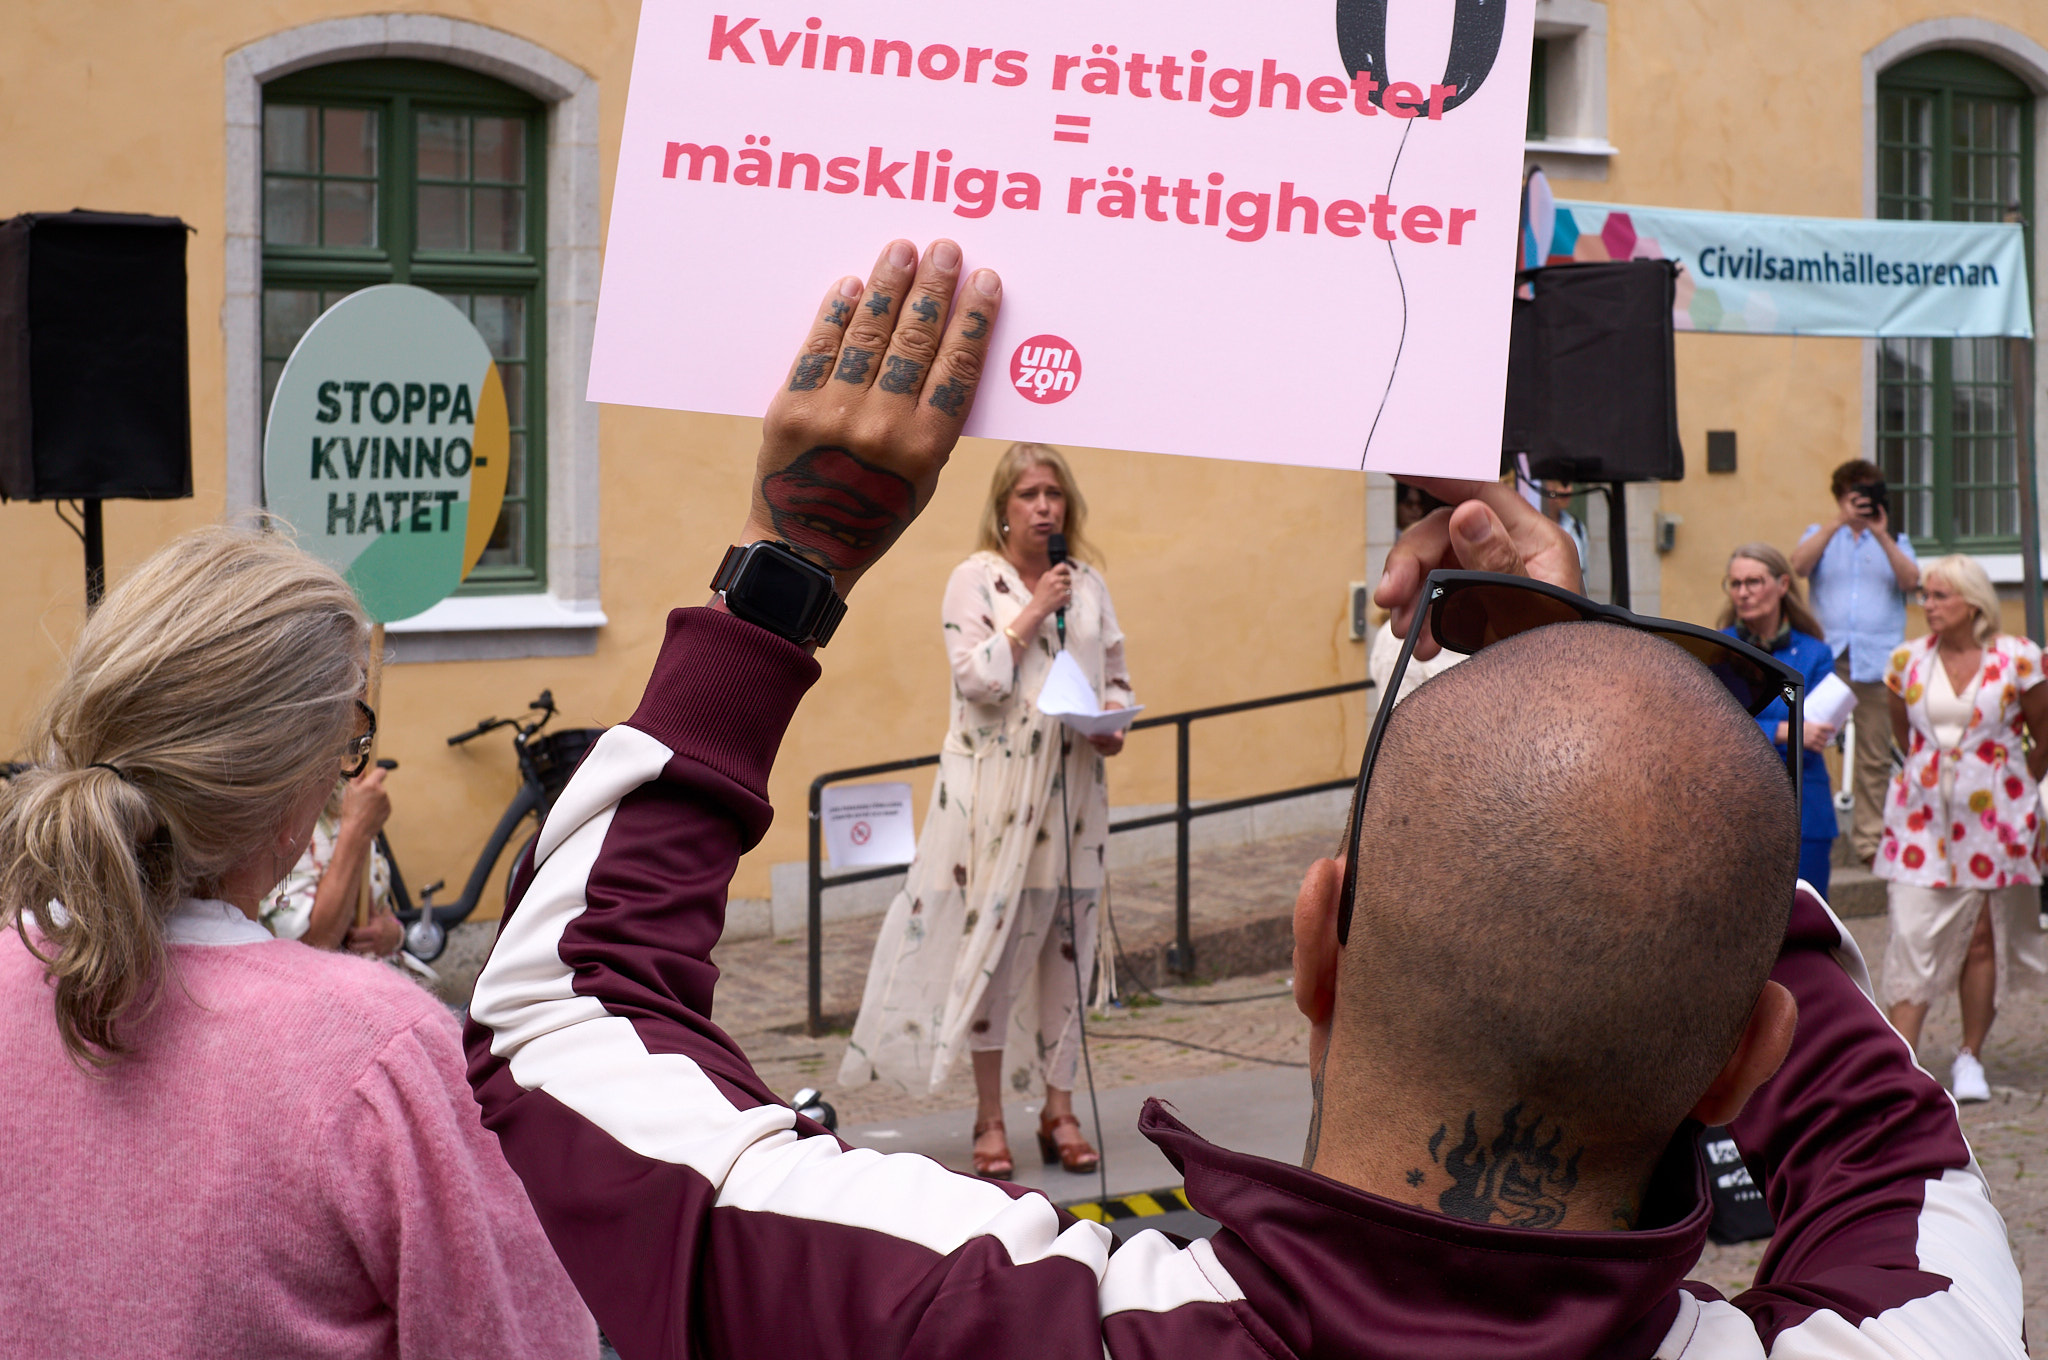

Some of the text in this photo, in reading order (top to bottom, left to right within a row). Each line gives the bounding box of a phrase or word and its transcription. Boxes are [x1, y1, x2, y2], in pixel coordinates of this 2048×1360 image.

[707, 14, 1029, 87] Kvinnors
[1051, 43, 1457, 121] rättigheter
[1053, 114, 1092, 144] =
[662, 134, 1477, 246] mänskliga rättigheter
[1698, 245, 2000, 288] Civilsamhällesarenan
[316, 381, 474, 425] STOPPA
[311, 437, 488, 479] KVINNO-
[327, 491, 460, 535] HATET
